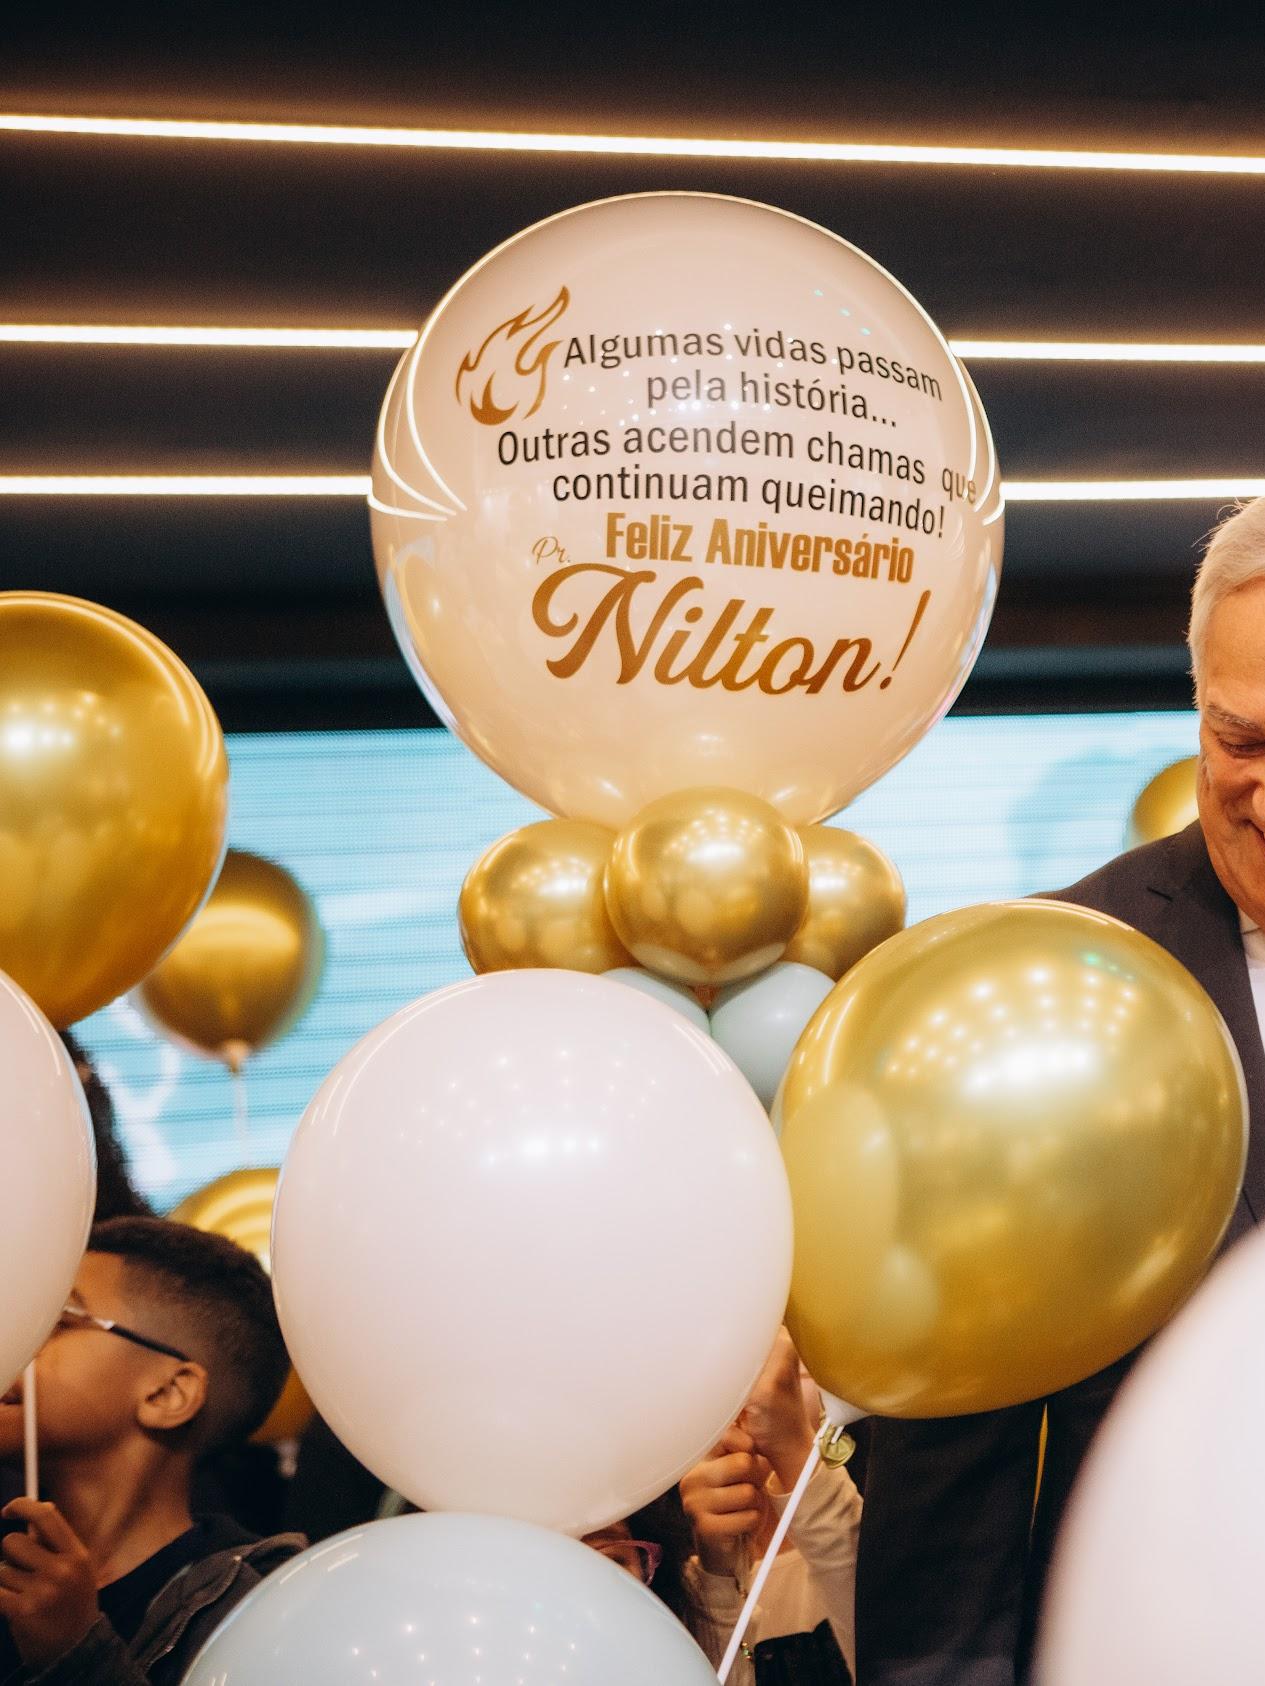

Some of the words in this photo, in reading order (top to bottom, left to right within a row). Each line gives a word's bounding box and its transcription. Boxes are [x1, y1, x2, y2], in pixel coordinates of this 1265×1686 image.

[563, 331, 724, 369] Algumas
[733, 327, 827, 366] vidas
[837, 342, 943, 402] passam
[647, 369, 726, 408] pela
[740, 371, 897, 428] história...
[497, 425, 611, 466] Outras
[623, 421, 795, 459] acendem
[806, 429, 926, 485] chamas
[942, 468, 976, 505] que
[552, 464, 749, 503] continuam
[761, 476, 945, 538] queimando!
[531, 536, 572, 566] Pr.
[605, 512, 692, 563] Feliz
[705, 518, 914, 584] Aniversário
[531, 562, 932, 695] Nilton!
